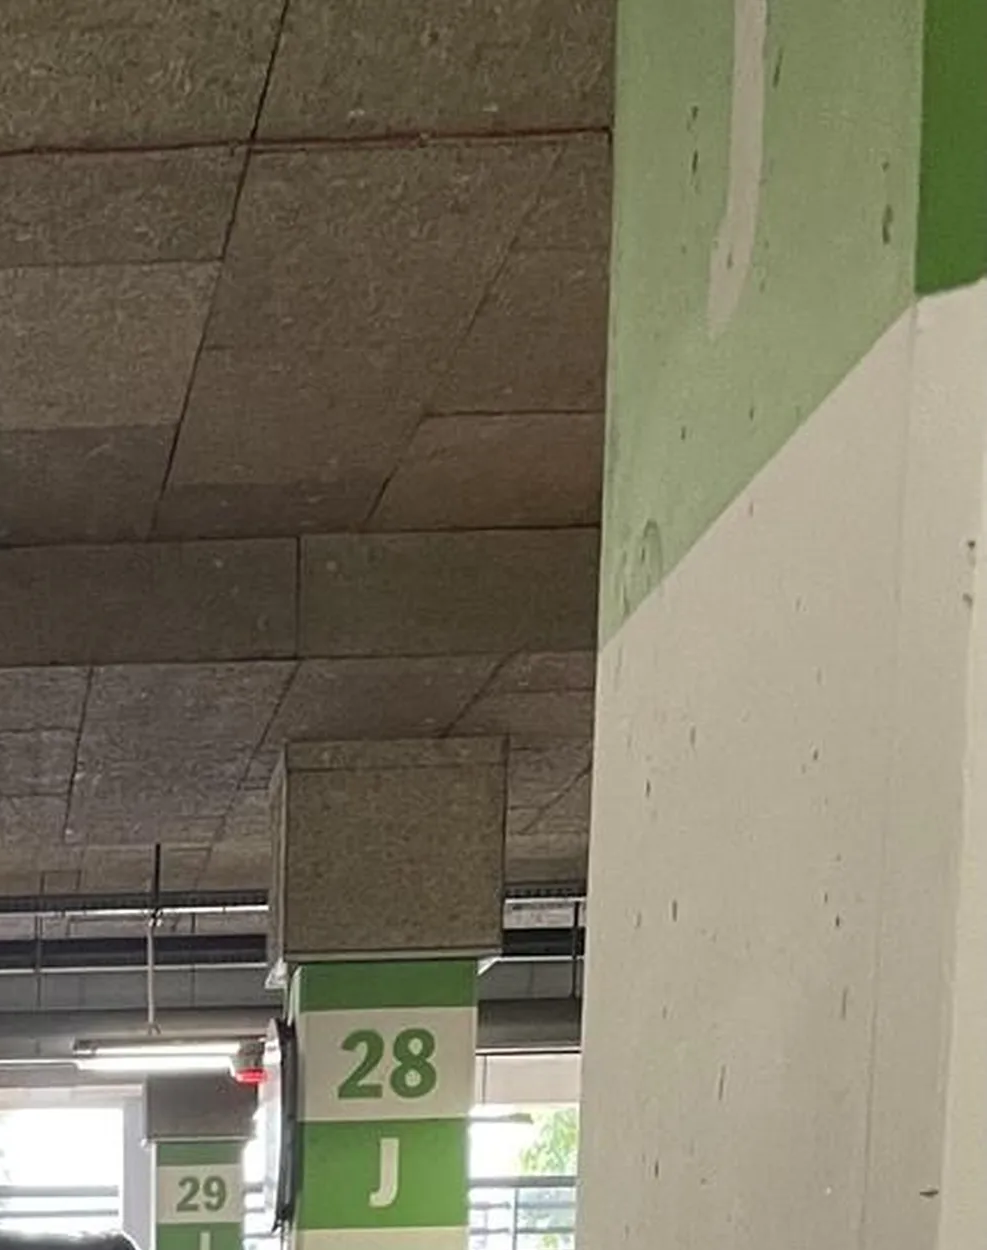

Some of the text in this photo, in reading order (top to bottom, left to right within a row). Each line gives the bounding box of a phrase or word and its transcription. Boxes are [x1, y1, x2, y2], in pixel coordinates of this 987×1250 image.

[338, 1028, 437, 1099] 28
[176, 1175, 227, 1212] 29
[369, 1137, 400, 1208] J
